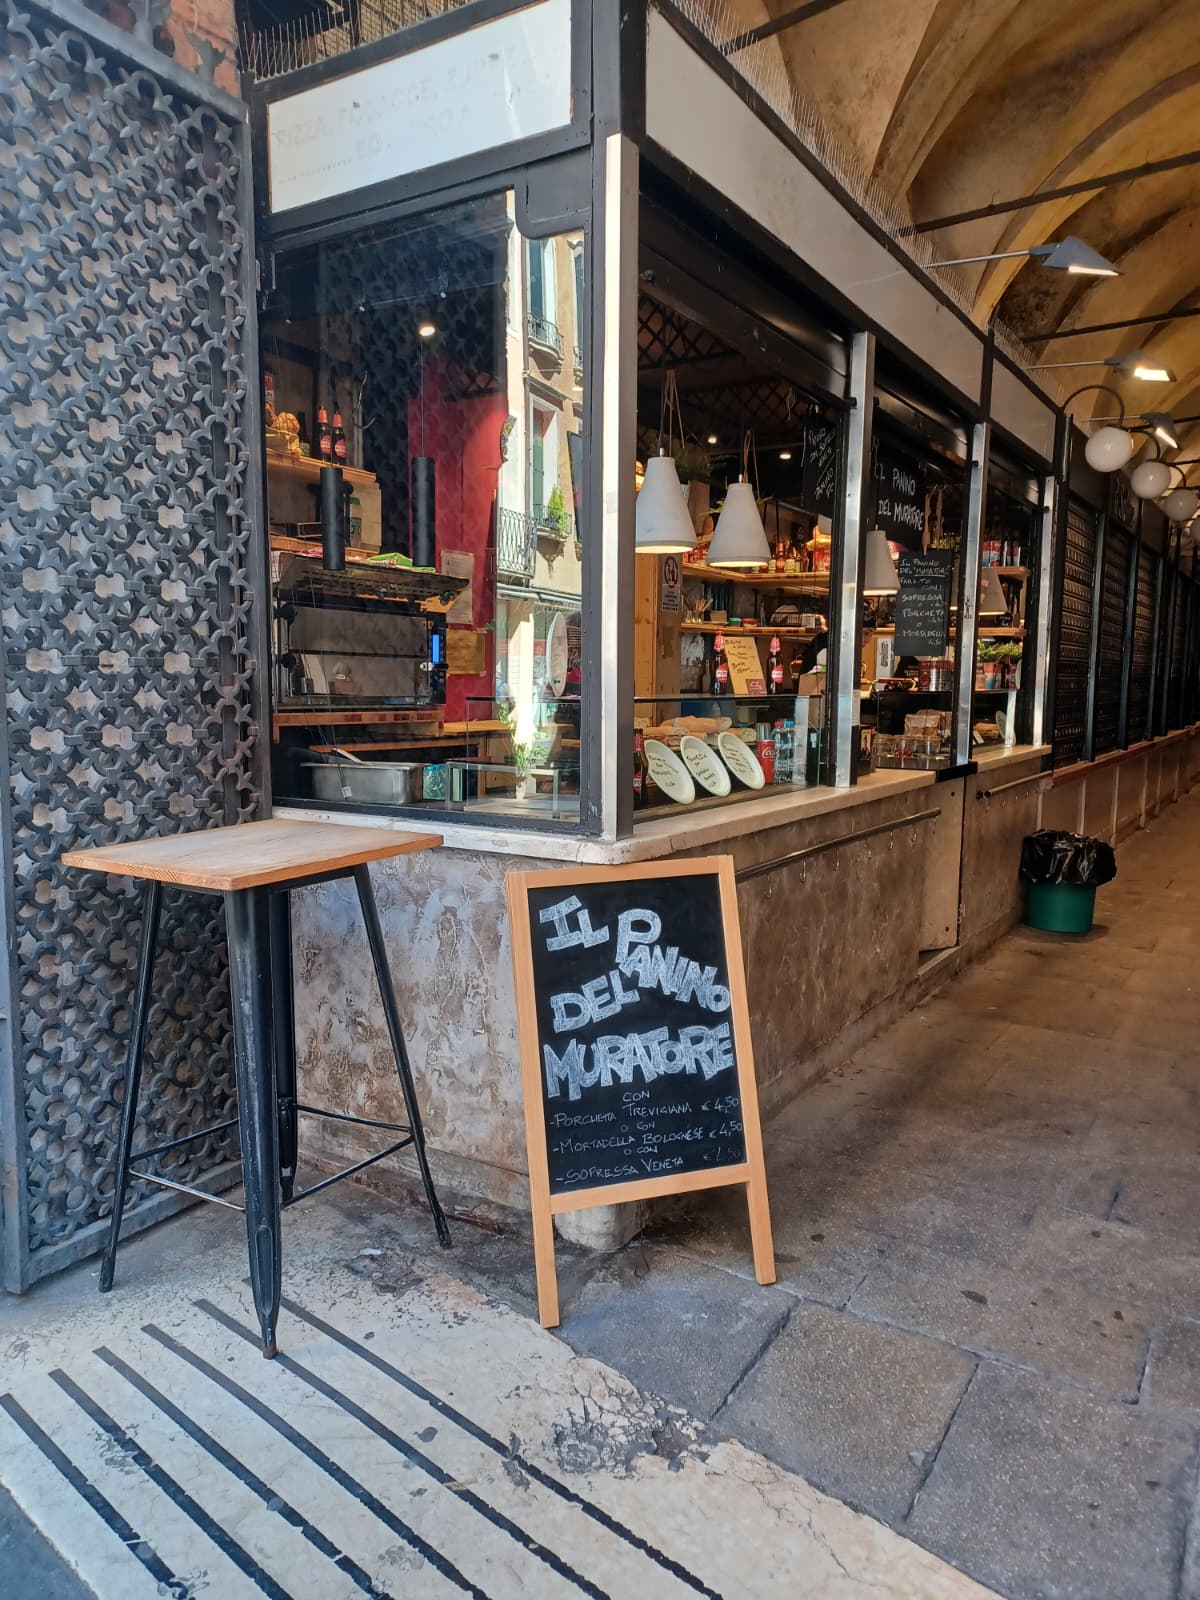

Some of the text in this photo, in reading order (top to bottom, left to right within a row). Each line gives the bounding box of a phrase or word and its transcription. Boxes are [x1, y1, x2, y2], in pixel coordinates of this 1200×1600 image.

[892, 467, 916, 497] PANINO
[878, 498, 892, 516] DEL
[539, 895, 731, 1013] IL PANINO
[550, 969, 640, 1033] DEL
[543, 1022, 734, 1100] MURATORE
[622, 1090, 650, 1102] CON
[621, 1102, 693, 1118] TREVIGIANA
[637, 1121, 655, 1131] CON
[642, 1127, 704, 1144] BOLOGNESE
[637, 1145, 658, 1154] CON
[641, 1157, 684, 1173] VENETA
